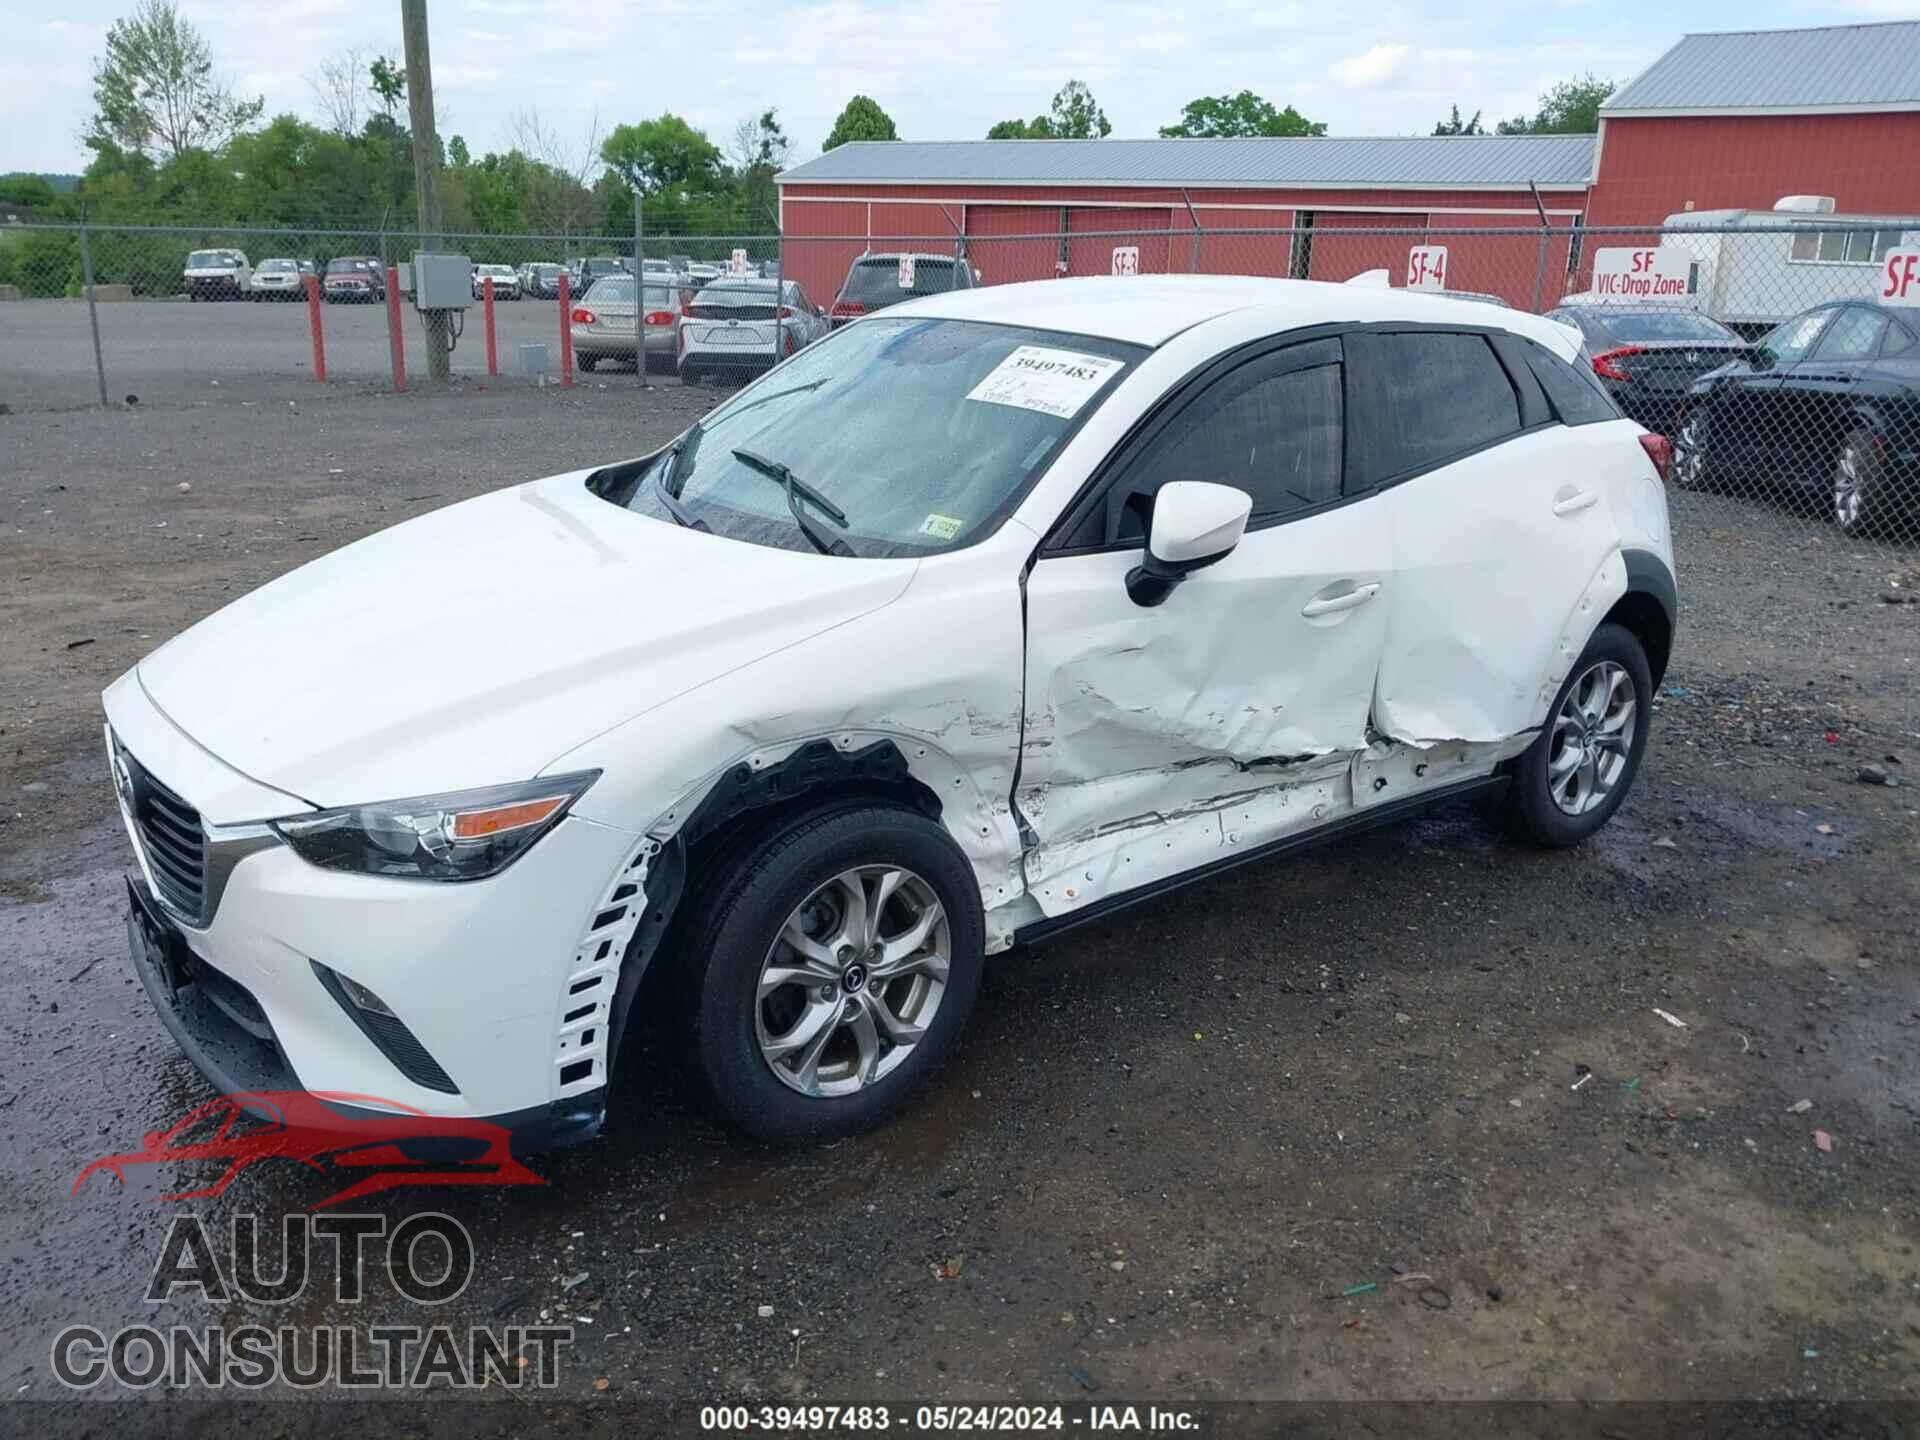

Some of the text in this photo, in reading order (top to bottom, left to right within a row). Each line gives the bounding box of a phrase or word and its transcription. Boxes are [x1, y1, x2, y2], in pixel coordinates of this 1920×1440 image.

[1409, 252, 1443, 284] SF-4
[1631, 251, 1655, 272] SF
[1597, 273, 1685, 297] VIC-Drop Zone
[1010, 357, 1099, 381] 39497483
